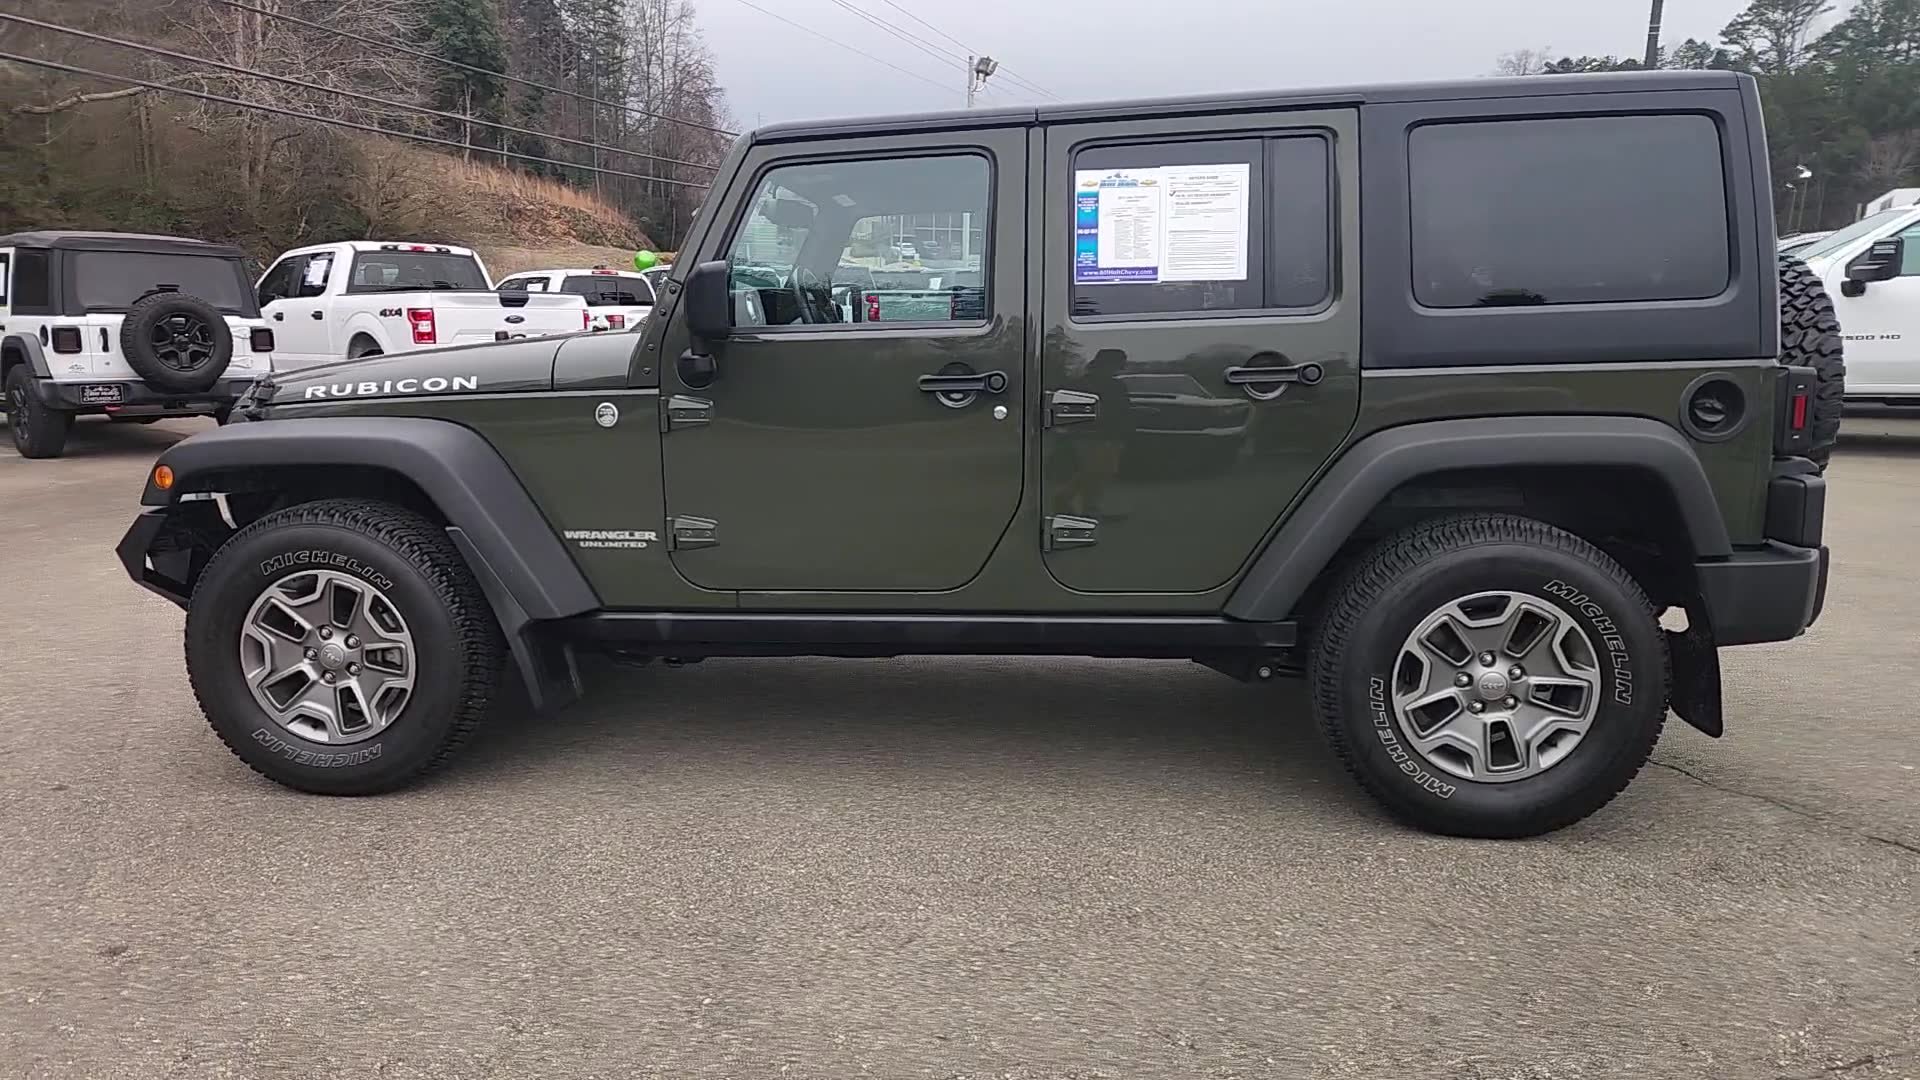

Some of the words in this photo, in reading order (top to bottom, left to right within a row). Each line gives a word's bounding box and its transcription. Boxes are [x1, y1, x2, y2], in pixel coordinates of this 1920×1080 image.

[304, 375, 478, 400] RUBICON
[563, 530, 659, 541] WRANGLER
[260, 550, 393, 591] MICHELIN
[1543, 579, 1633, 705] MICHELIN
[252, 727, 383, 769] MICHELIN
[1368, 677, 1456, 799] MICHELIN
